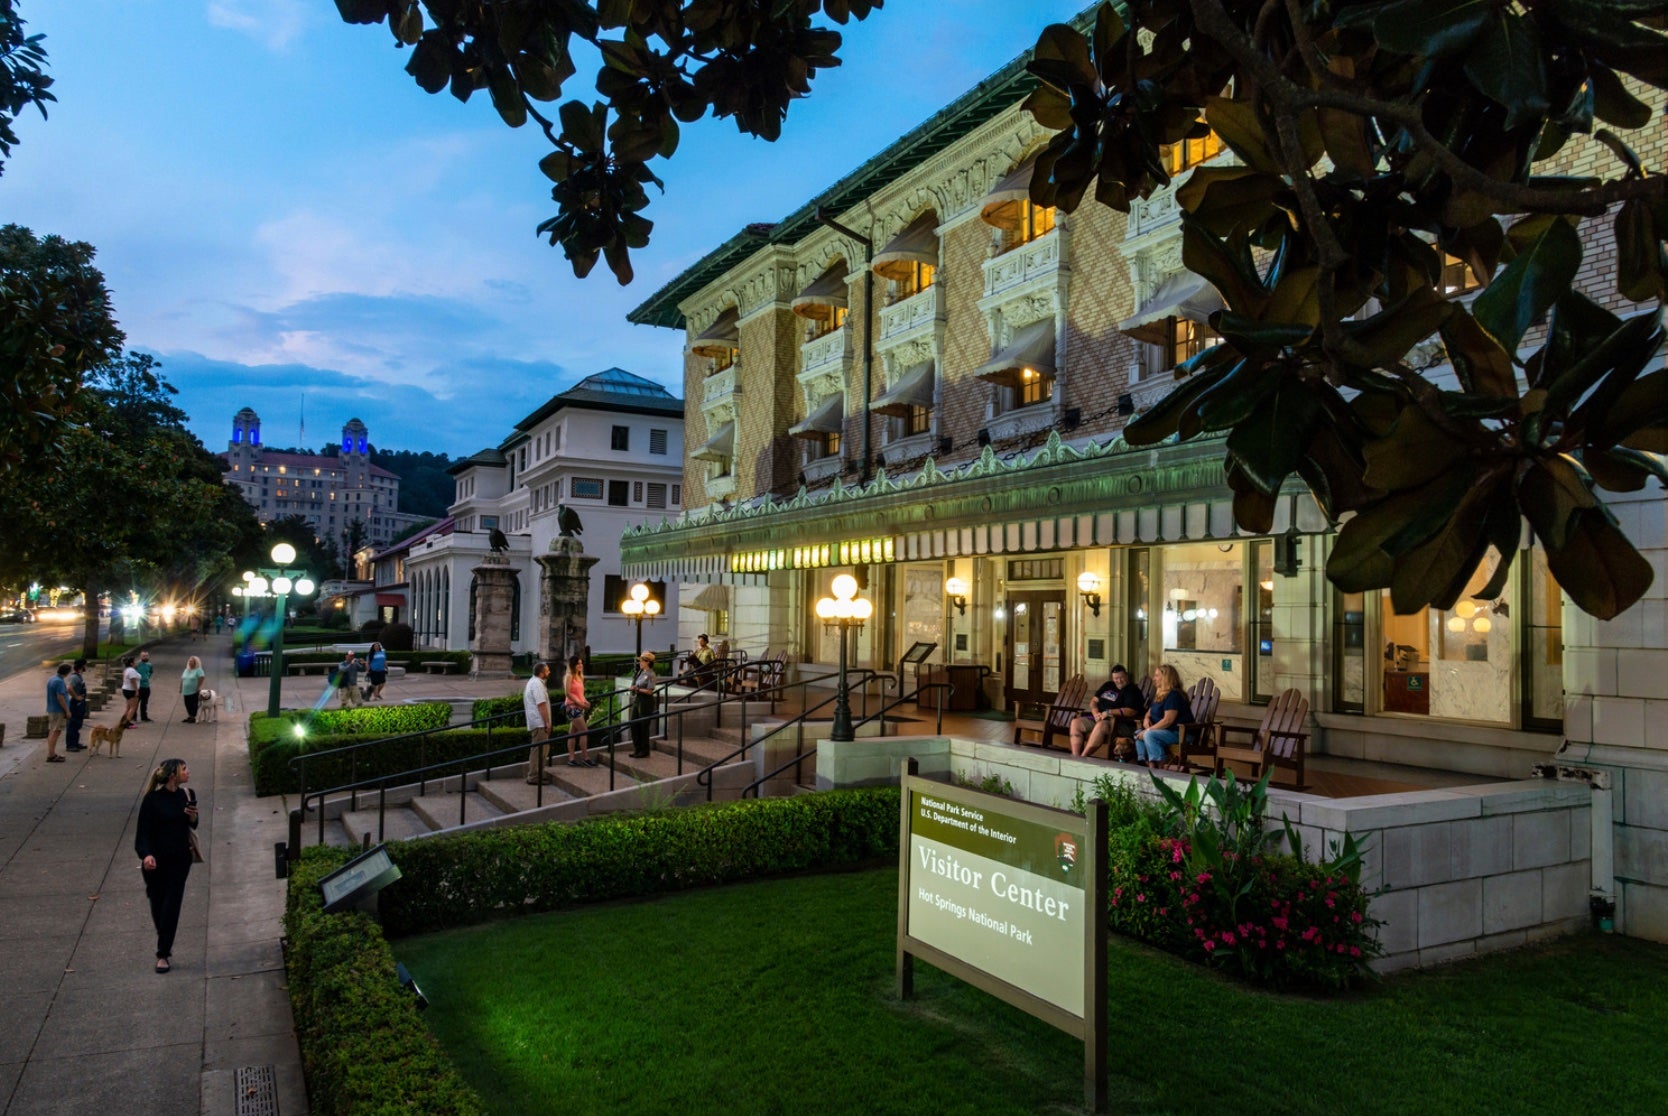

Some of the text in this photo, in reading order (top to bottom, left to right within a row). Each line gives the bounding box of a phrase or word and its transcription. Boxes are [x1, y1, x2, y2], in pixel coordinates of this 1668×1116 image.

[921, 797, 984, 822] National Park Service
[921, 808, 1017, 844] U.S. Department of the Interior
[918, 845, 1070, 921] Visitor Center
[918, 888, 1033, 945] Hot Springs National Park
